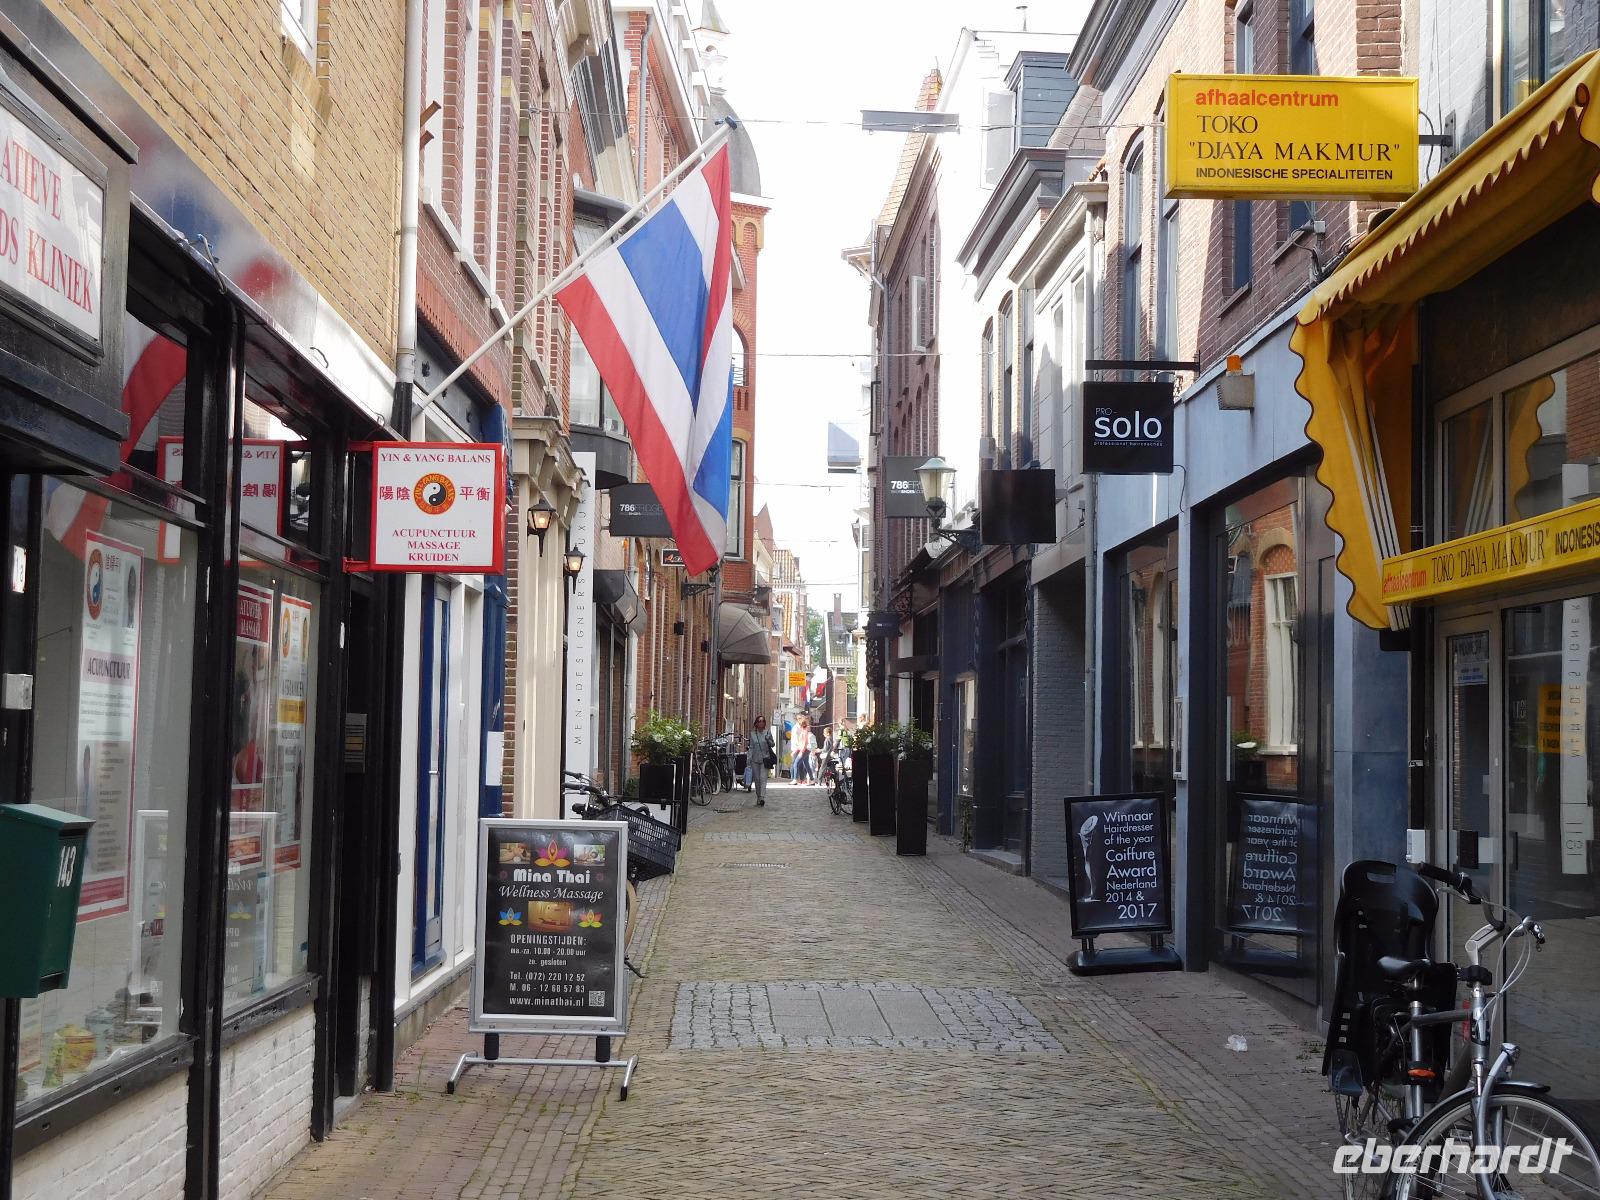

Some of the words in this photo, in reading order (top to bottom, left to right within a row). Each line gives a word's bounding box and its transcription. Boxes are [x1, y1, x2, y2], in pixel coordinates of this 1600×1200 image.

[1195, 89, 1339, 107] afhaalcentrum
[1197, 115, 1258, 134] TOKO
[1189, 141, 1264, 160] "DJAYA
[1275, 143, 1400, 162] MAKMUR"
[1195, 168, 1288, 179] INDONESISCHE
[1292, 169, 1393, 180] SPECIALITEITEN
[27, 228, 93, 313] KLINIEK
[1094, 410, 1162, 439] solo
[381, 453, 400, 462] YIN
[403, 453, 411, 462] &
[415, 454, 444, 462] YANG
[448, 454, 491, 463] BALANS
[392, 528, 476, 538] ACUPUNCTUUR
[407, 541, 461, 550] MASSAGE
[408, 553, 459, 562] KRUIDEN
[1384, 569, 1427, 593] afhaalcentrum
[1431, 554, 1455, 584] TOKO
[1103, 811, 1154, 823] Winnaar
[1103, 822, 1154, 834] Hairdresser
[1104, 834, 1115, 846] of
[1116, 834, 1131, 844] the
[1133, 835, 1155, 846] year
[1105, 846, 1155, 862] Coiffure
[57, 845, 77, 888] 143
[1106, 860, 1157, 879] Award
[513, 868, 552, 883] Mina
[556, 869, 591, 884] Thai
[1106, 877, 1157, 891] Nederland
[498, 884, 551, 899] Wellness
[553, 887, 604, 903] Massage
[1105, 892, 1132, 903] 2014
[1136, 890, 1145, 901] &
[1117, 902, 1158, 919] 2017
[510, 933, 587, 946] OPENINGSTIJDEN:
[534, 947, 551, 955] 10.00
[556, 948, 574, 956] 20.00
[540, 958, 567, 967] gesloten
[509, 971, 523, 980] Tel.
[525, 972, 545, 982] (072)
[548, 972, 562, 981] 220
[564, 973, 574, 982] 12
[576, 973, 585, 982] 52
[509, 982, 519, 992] M.
[521, 983, 531, 992] 06
[539, 984, 549, 992] 12
[563, 984, 573, 993] 57
[575, 984, 585, 993] 83
[509, 996, 584, 1008] www.minathai.nl
